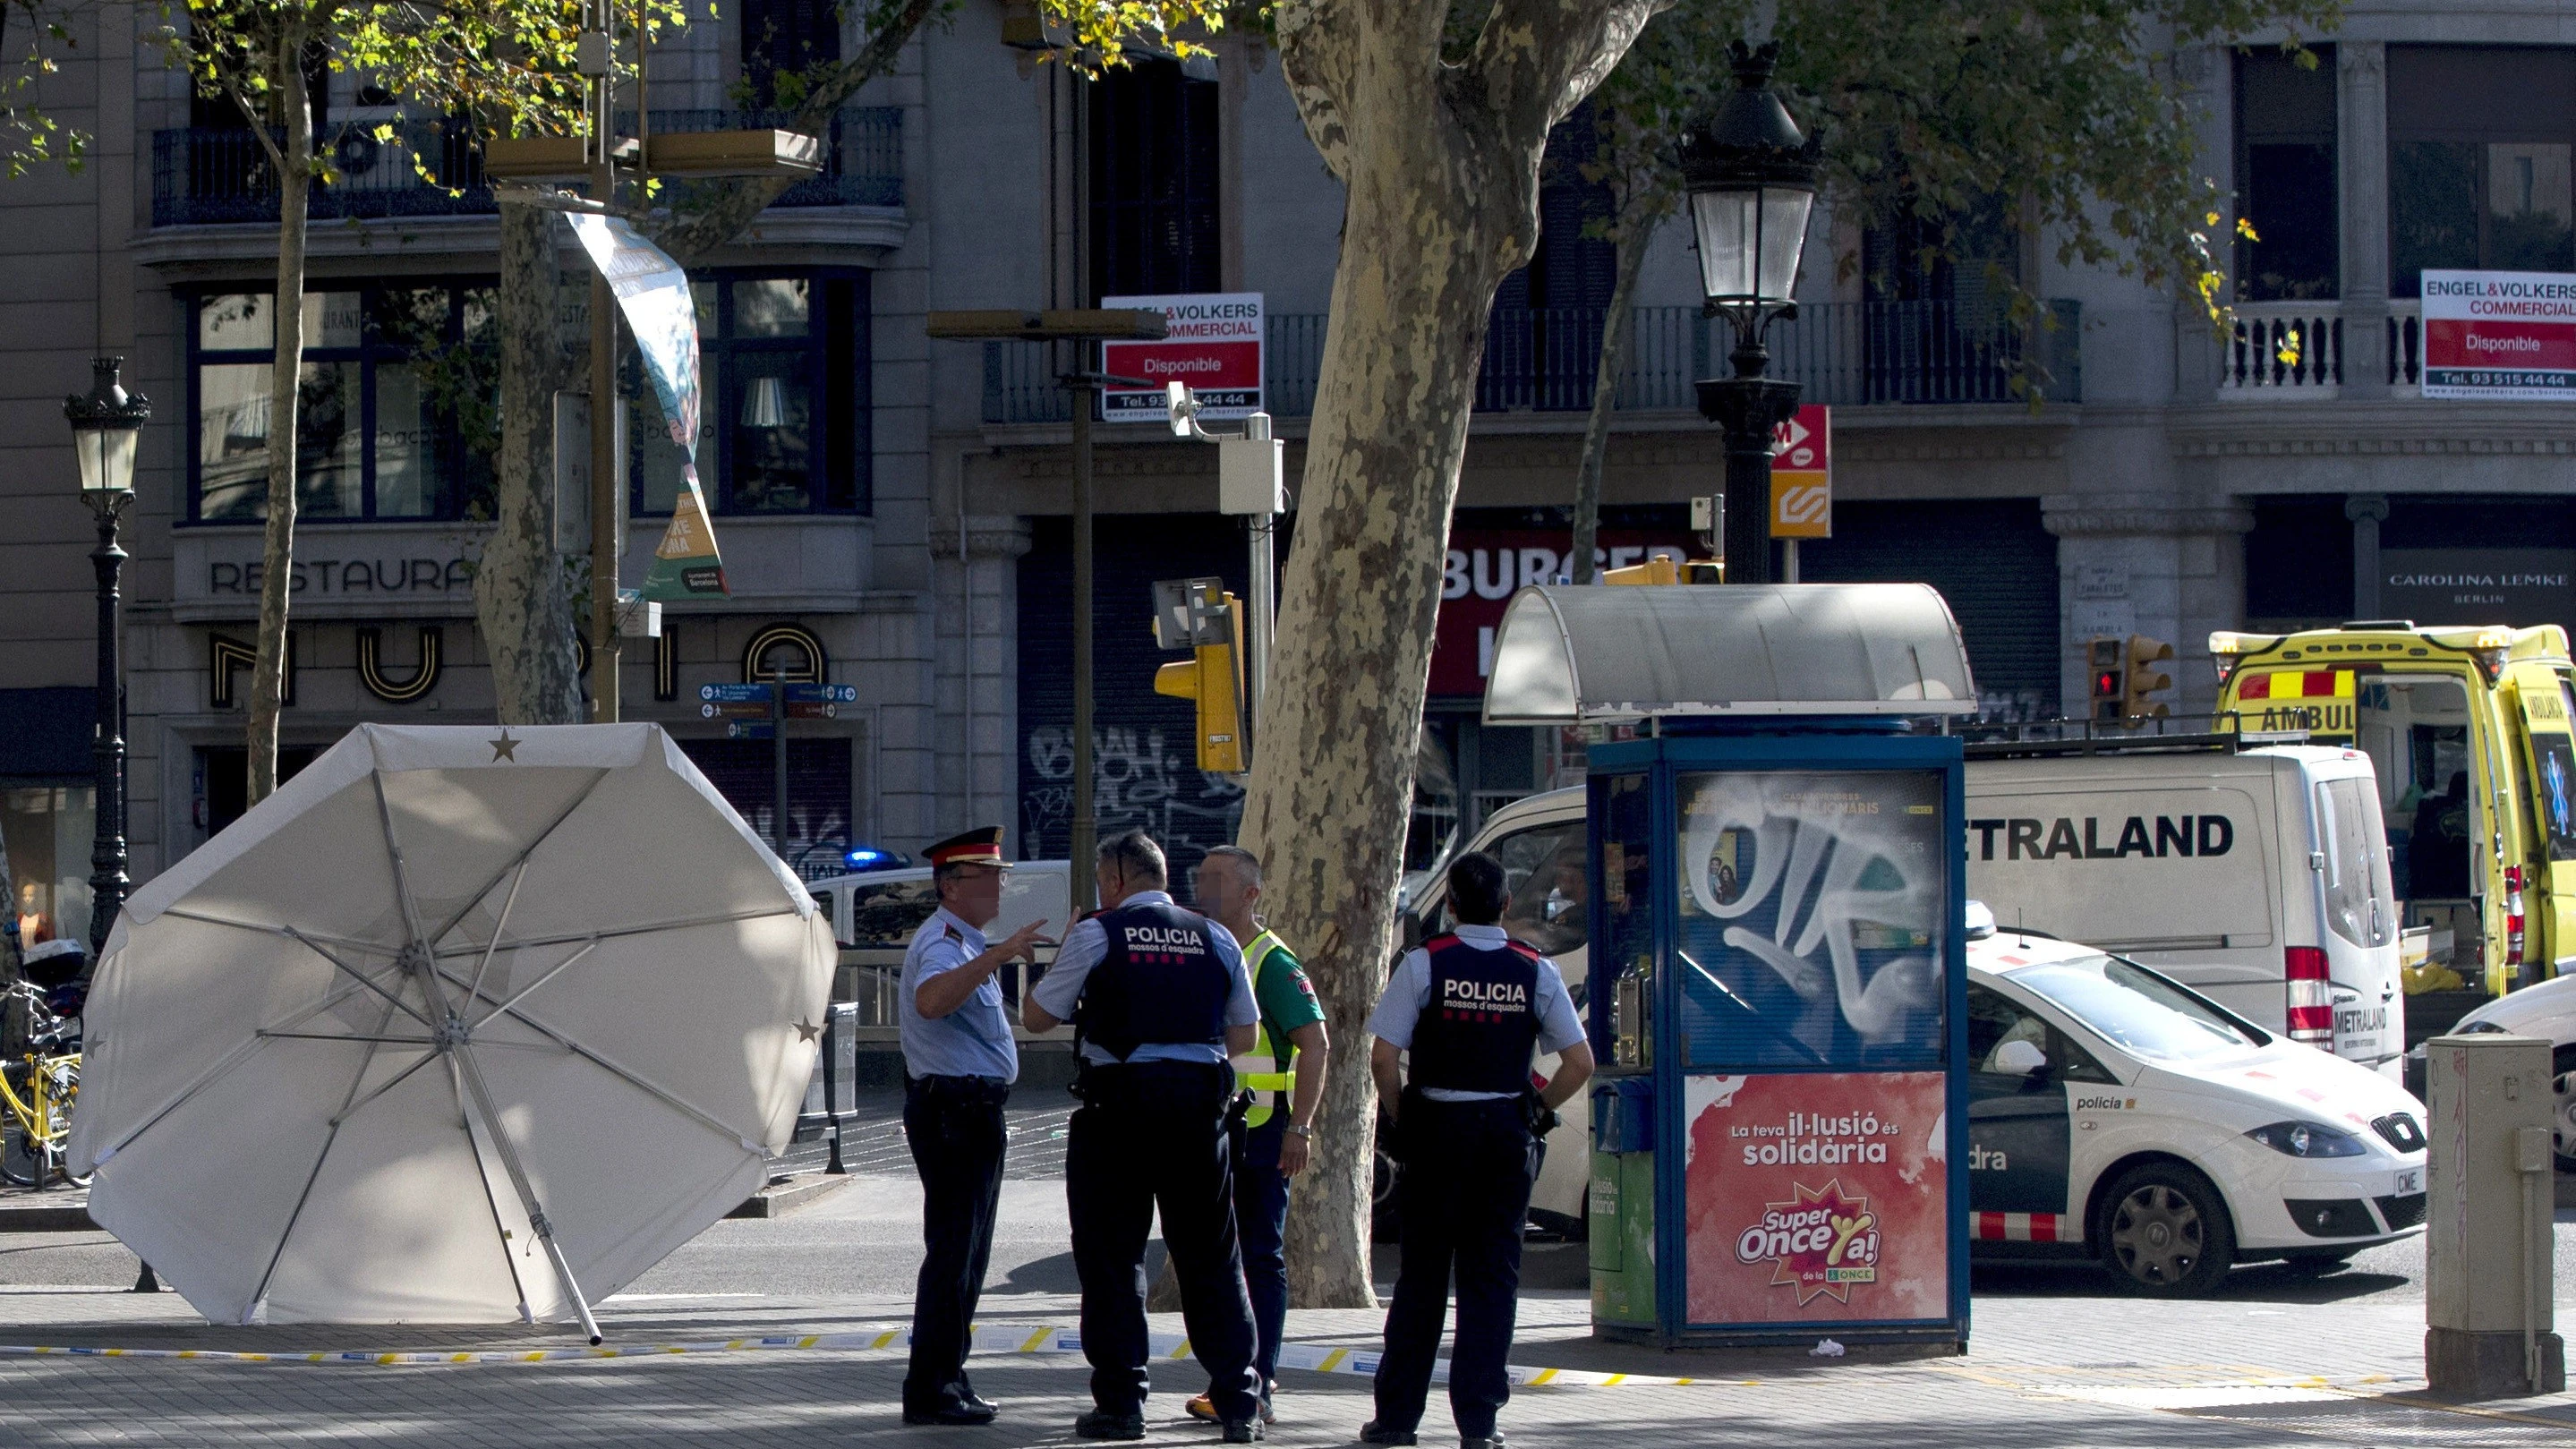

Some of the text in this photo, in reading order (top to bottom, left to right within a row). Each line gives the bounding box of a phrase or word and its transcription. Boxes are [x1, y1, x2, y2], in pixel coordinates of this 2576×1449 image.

[2427, 281, 2576, 299] ENGEL&VOLKERS
[2470, 300, 2576, 316] COMMERCIAL
[1166, 322, 1257, 337] MMERCIAL
[2466, 334, 2540, 354] Disponible
[1145, 358, 1222, 375] Disponible
[2442, 372, 2566, 386] Tel. 93 515 44 44
[1121, 395, 1166, 408] Tel. 93
[1225, 394, 1245, 405] 44
[2390, 574, 2569, 586] CAROLINA LEMKE
[2454, 593, 2504, 604] BERLIN
[1965, 814, 2234, 861] TRALAND
[1124, 926, 1203, 947] POLICIA
[1128, 943, 1159, 952] mossos
[1444, 979, 1526, 1002] POLICIA
[1444, 999, 1478, 1010] mossos
[2334, 1007, 2387, 1035] METRALAND
[1731, 1125, 1749, 1138] La
[1753, 1124, 1785, 1137] teva
[1882, 1122, 1899, 1135] és
[1744, 1137, 1887, 1165] solidària
[1968, 1144, 2007, 1171] dra
[2398, 1172, 2418, 1194] CME
[1765, 1208, 1831, 1231] Super
[1739, 1225, 1832, 1260] Once
[1803, 1270, 1872, 1281] de la ONCE
